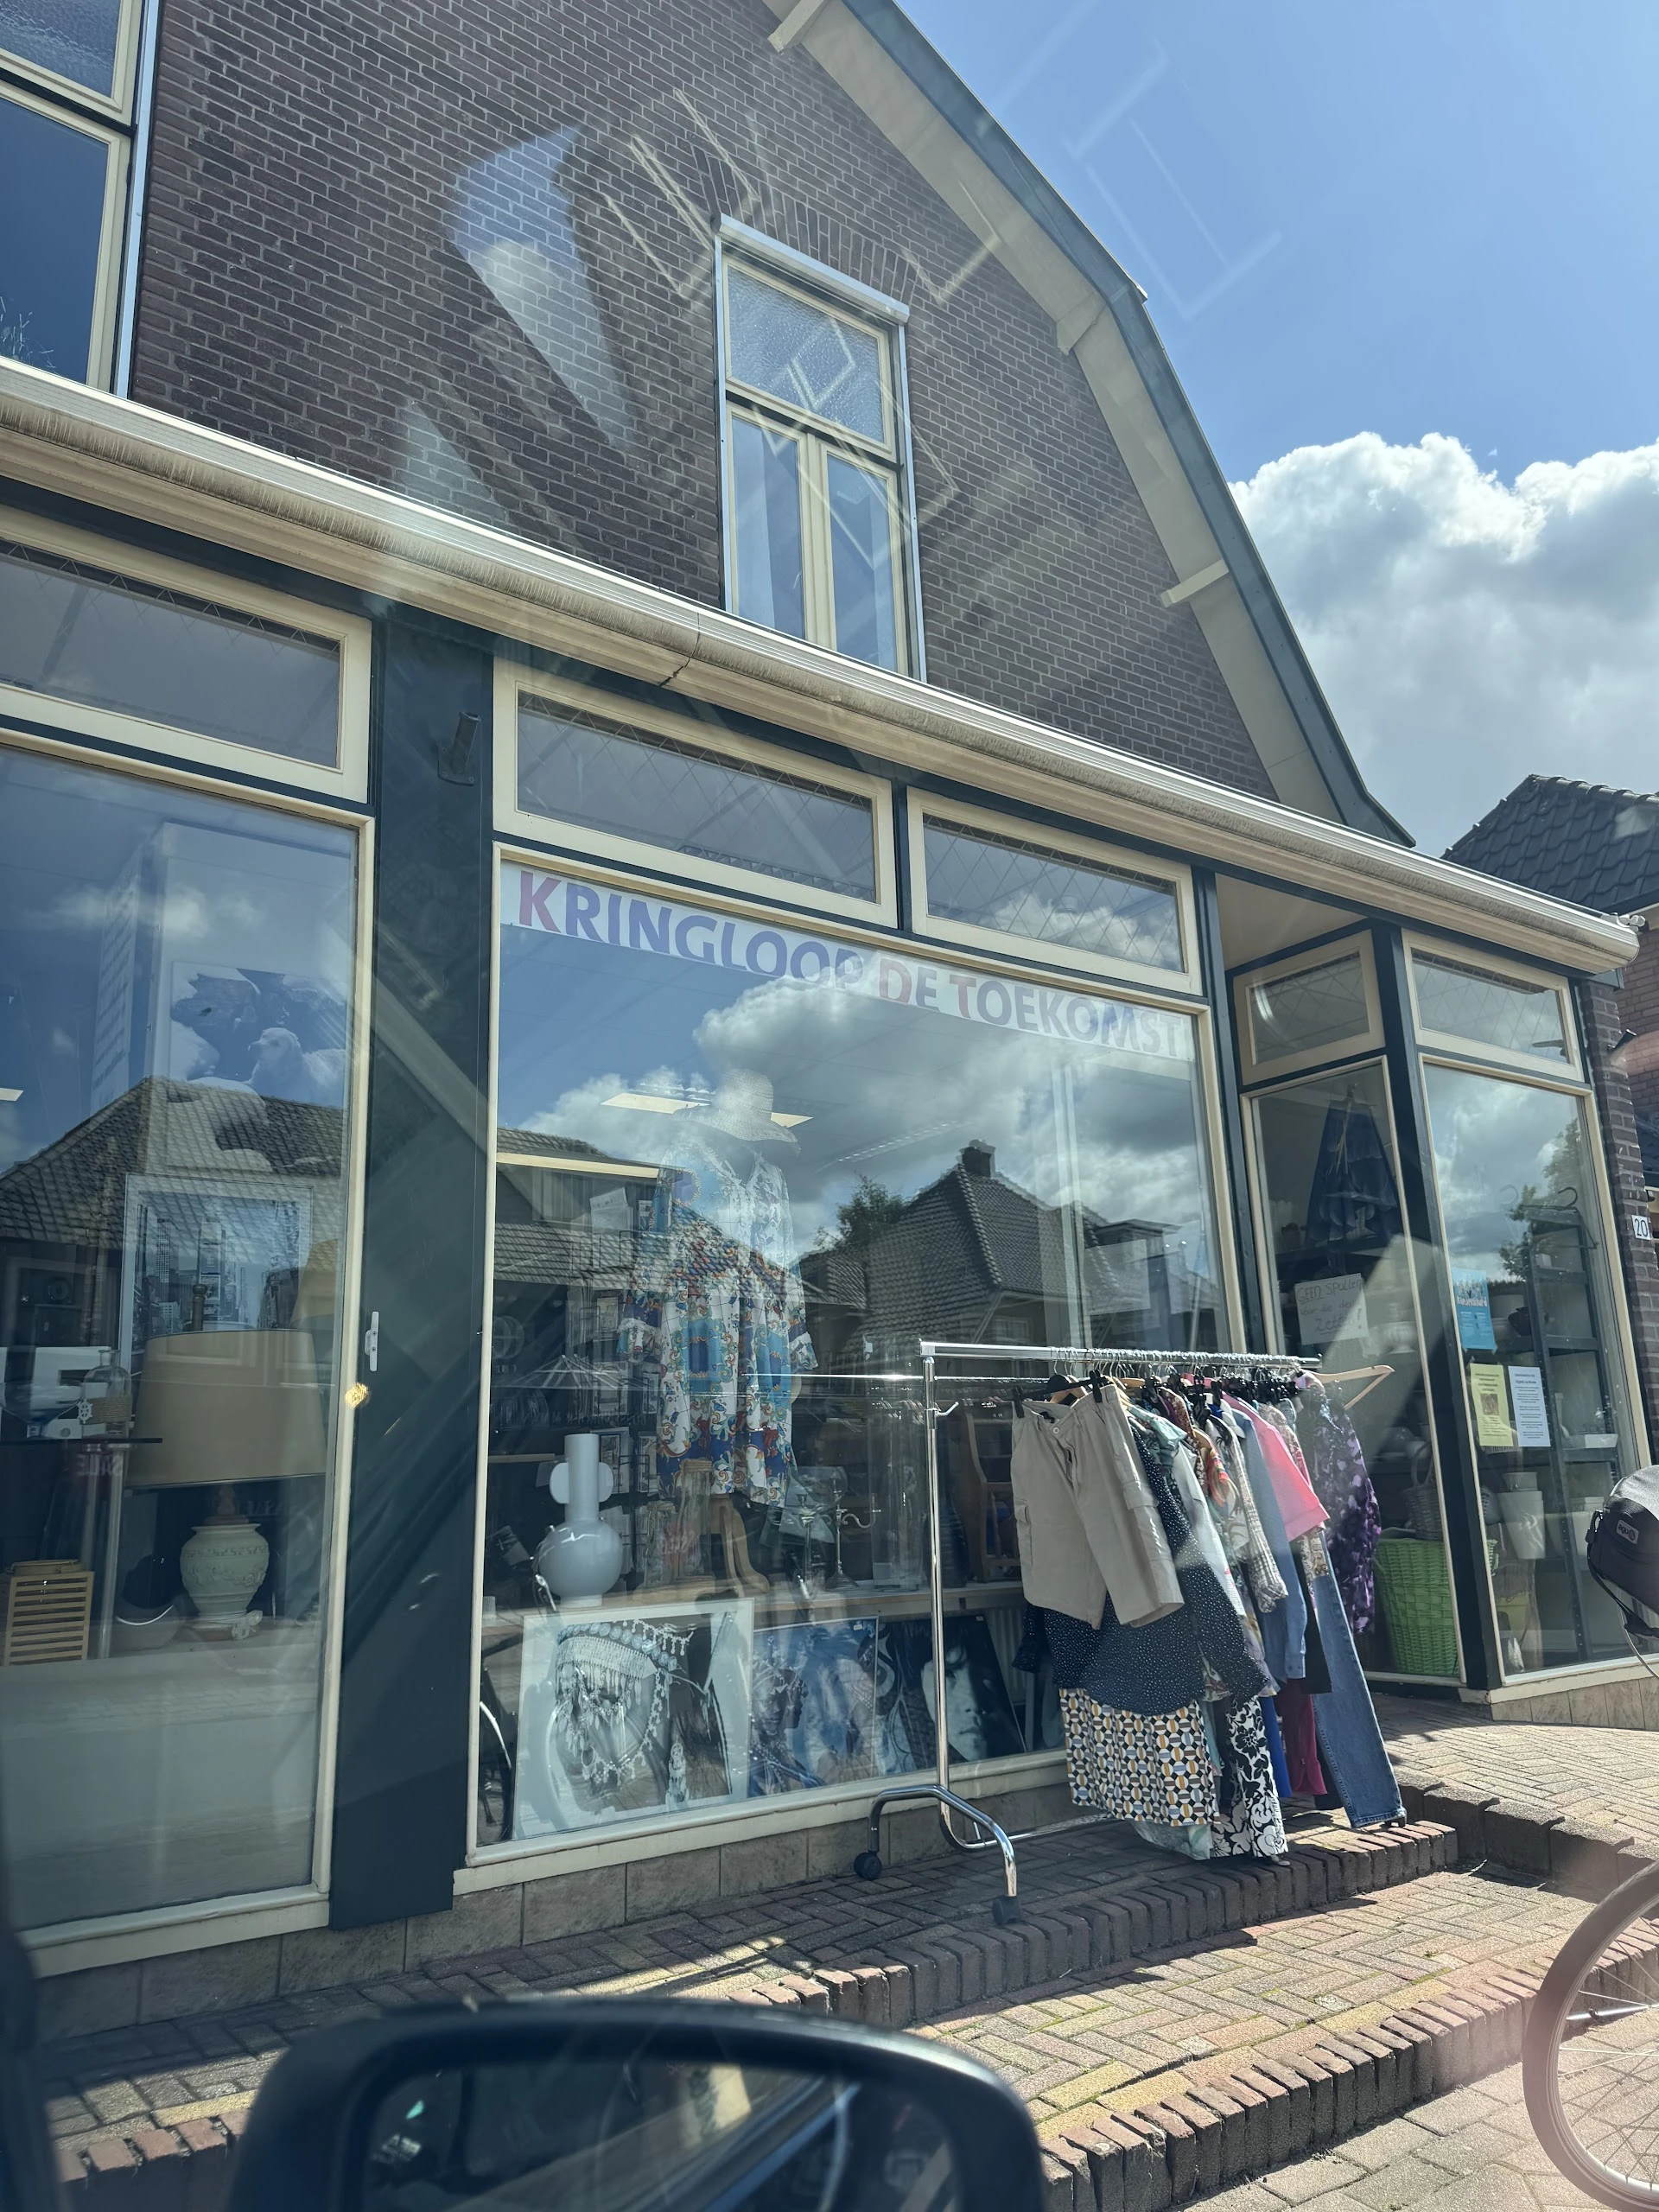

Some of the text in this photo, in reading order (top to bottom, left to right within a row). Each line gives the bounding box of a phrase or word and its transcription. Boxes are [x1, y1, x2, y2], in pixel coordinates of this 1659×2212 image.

[519, 871, 1181, 1058] KRINGLOOP DE TOEKOMST
[1634, 1217, 1649, 1237] 20
